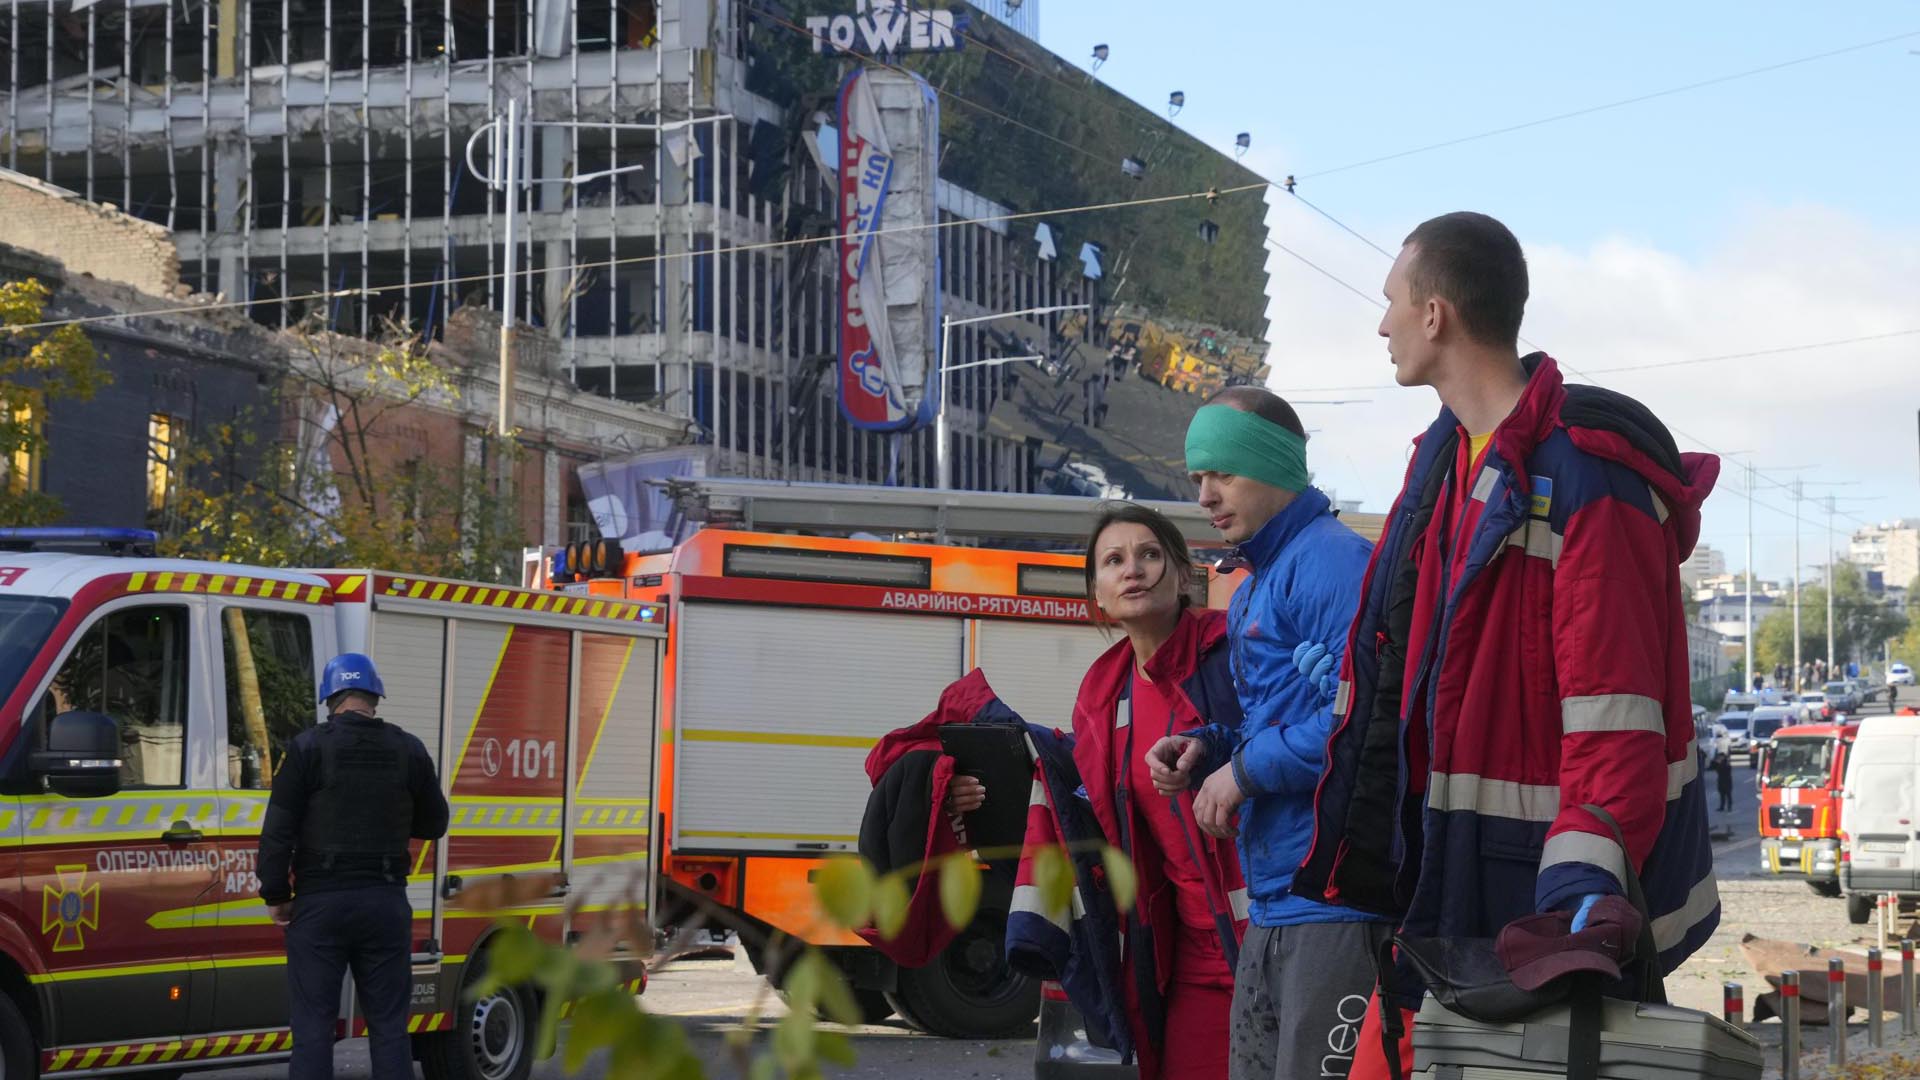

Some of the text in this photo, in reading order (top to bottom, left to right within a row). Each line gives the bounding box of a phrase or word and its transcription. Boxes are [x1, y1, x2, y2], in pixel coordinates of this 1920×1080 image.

[806, 10, 955, 54] TOWER
[881, 591, 1089, 618] АВАРІЙНО-РЯТУВАЛЬНА
[506, 739, 556, 779] 101
[1320, 994, 1369, 1077] neo
